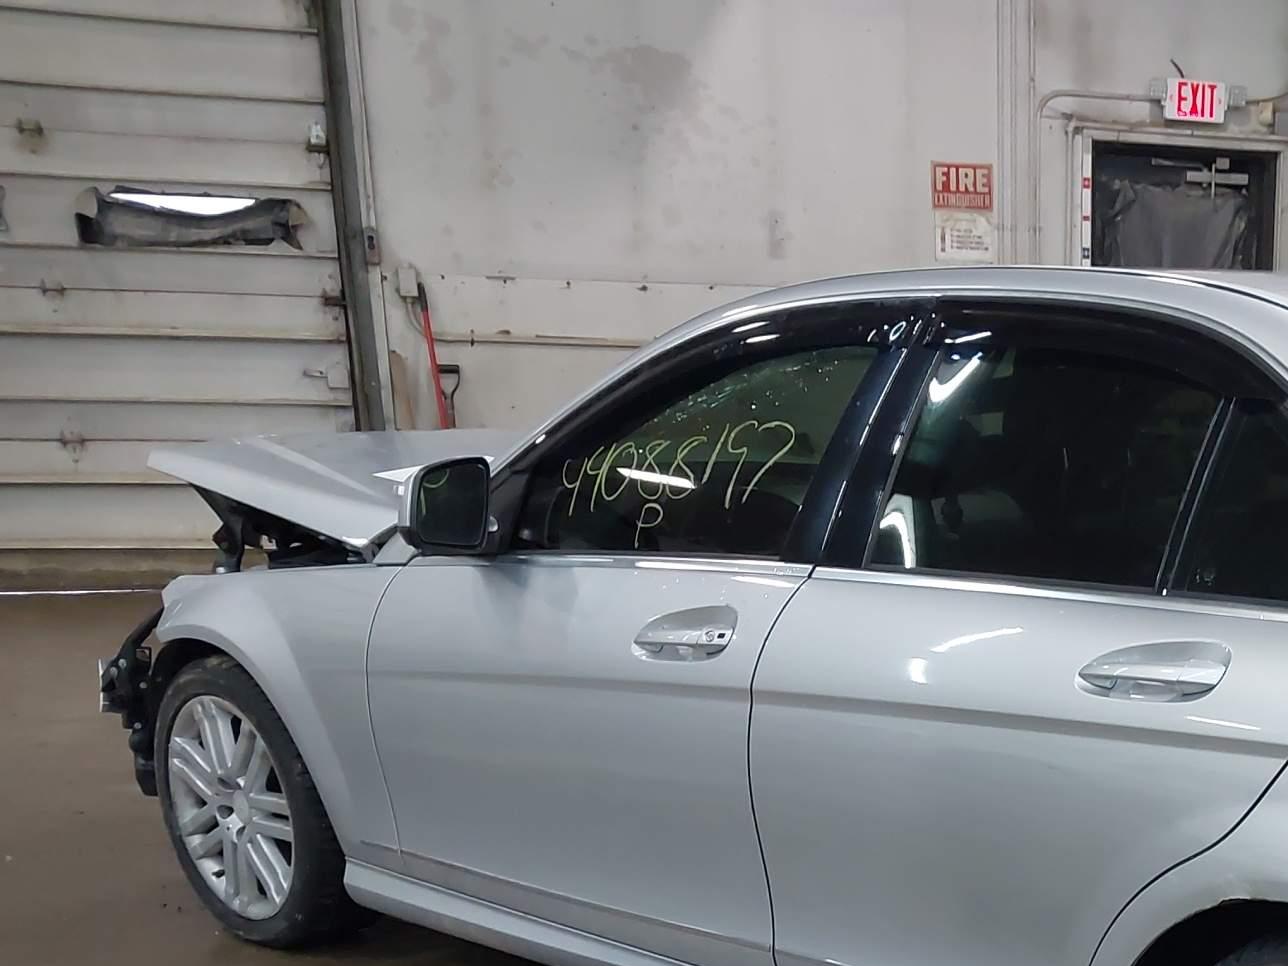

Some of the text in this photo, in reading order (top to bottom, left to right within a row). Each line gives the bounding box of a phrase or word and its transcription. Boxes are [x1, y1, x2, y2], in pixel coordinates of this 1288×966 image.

[1177, 82, 1217, 118] EXIT
[935, 165, 990, 193] FIRE
[634, 502, 664, 549] P
